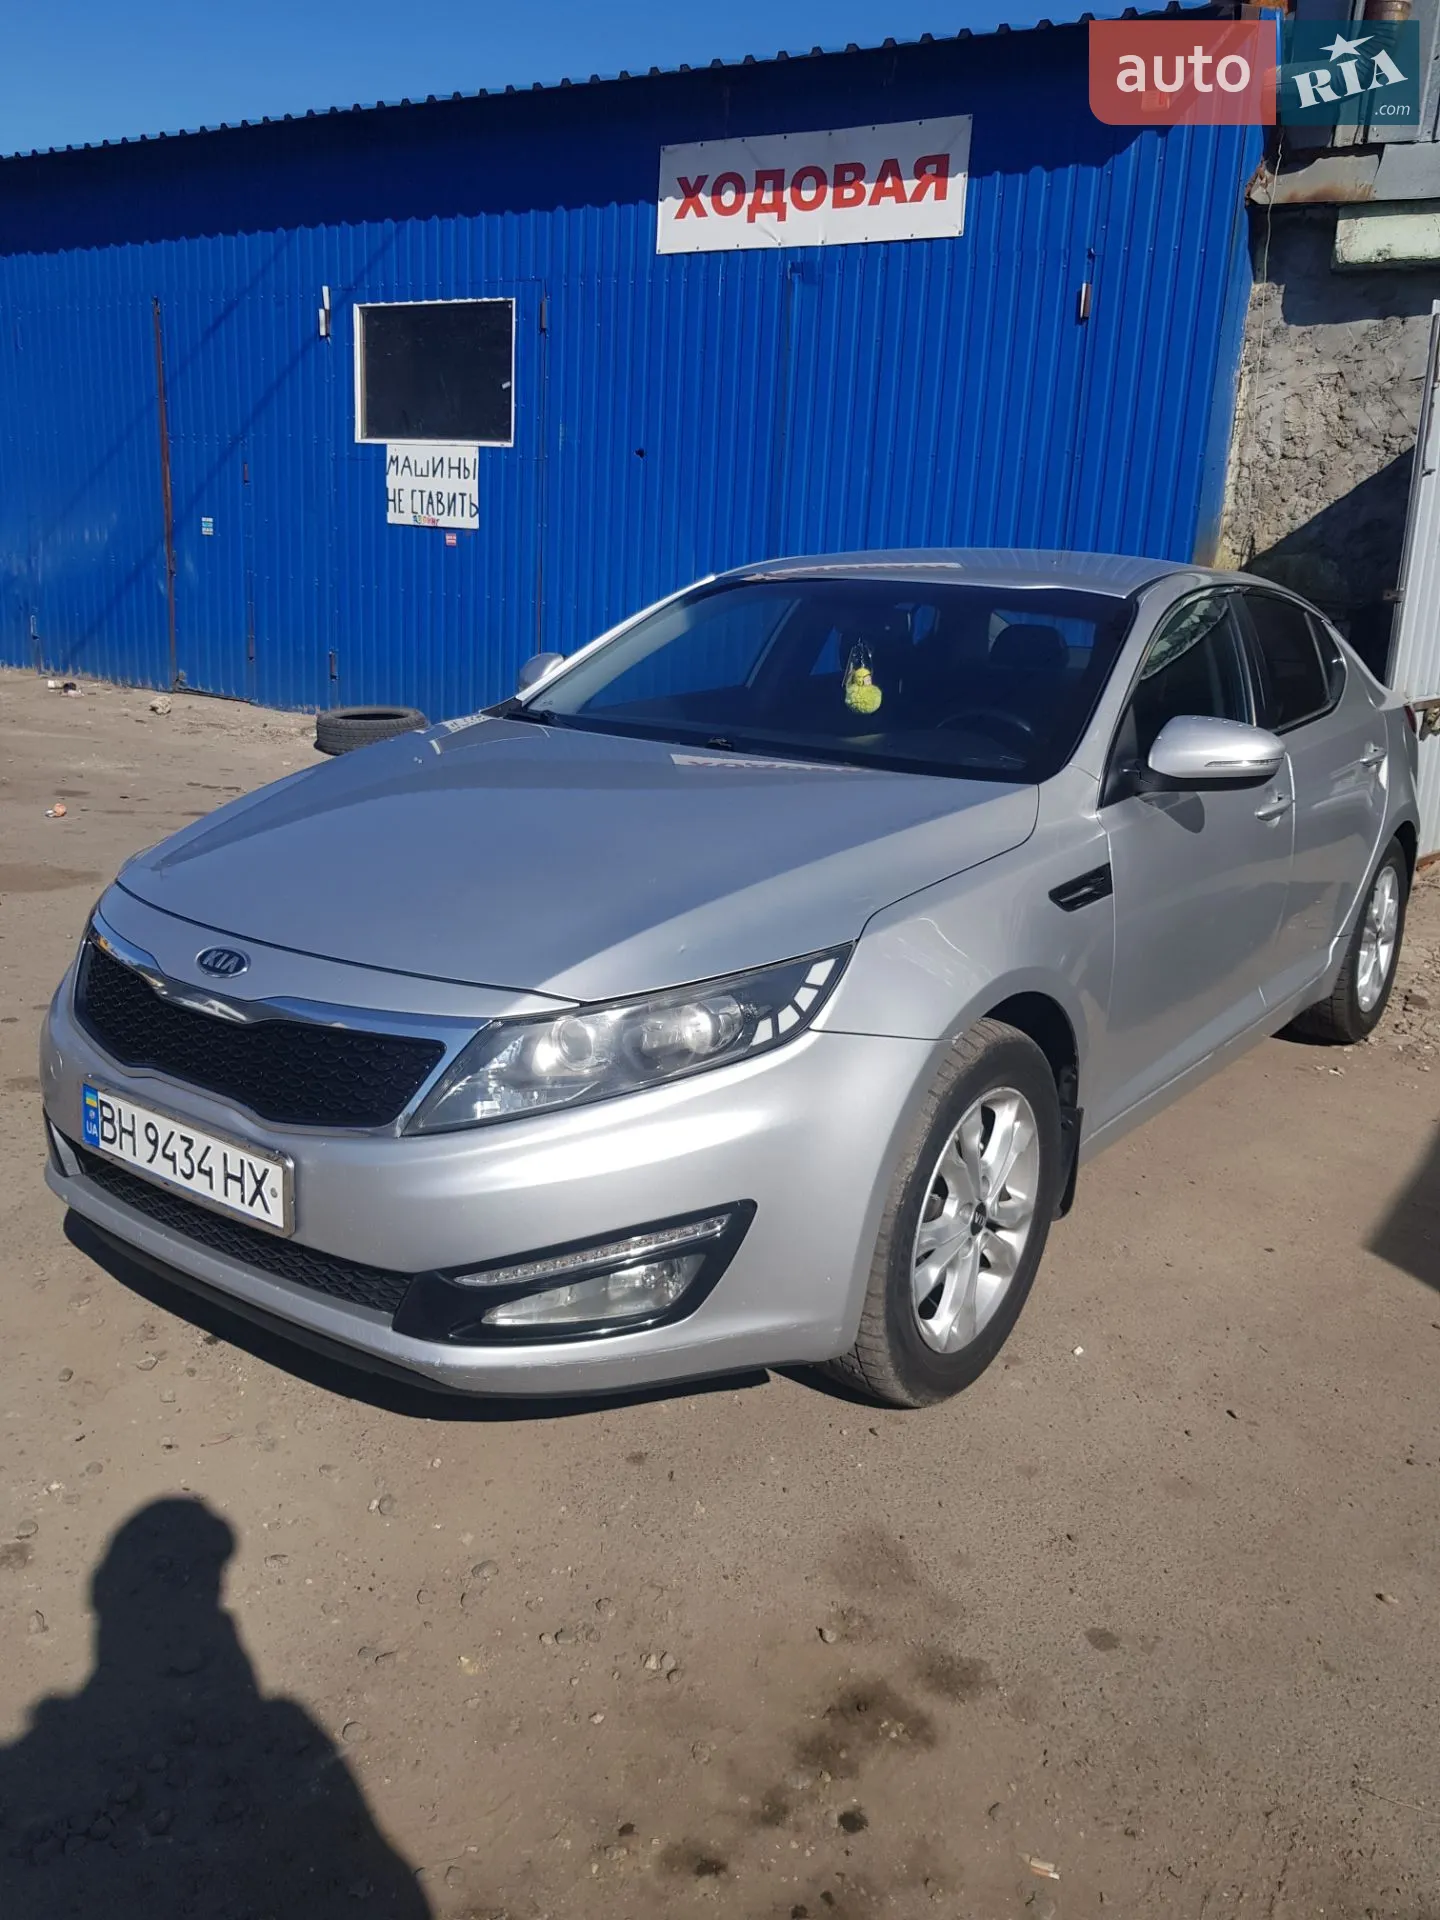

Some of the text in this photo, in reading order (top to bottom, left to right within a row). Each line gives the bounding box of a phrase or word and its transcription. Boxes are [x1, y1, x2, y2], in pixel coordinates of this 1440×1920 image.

[674, 153, 951, 224] ХОДОВАЯ
[386, 455, 477, 481] МАШИНЫ
[386, 487, 480, 518] НЕ СТАВИТЬ
[202, 950, 240, 973] KIA
[86, 1122, 98, 1137] UA
[100, 1101, 271, 1215] BH 9434 HX
